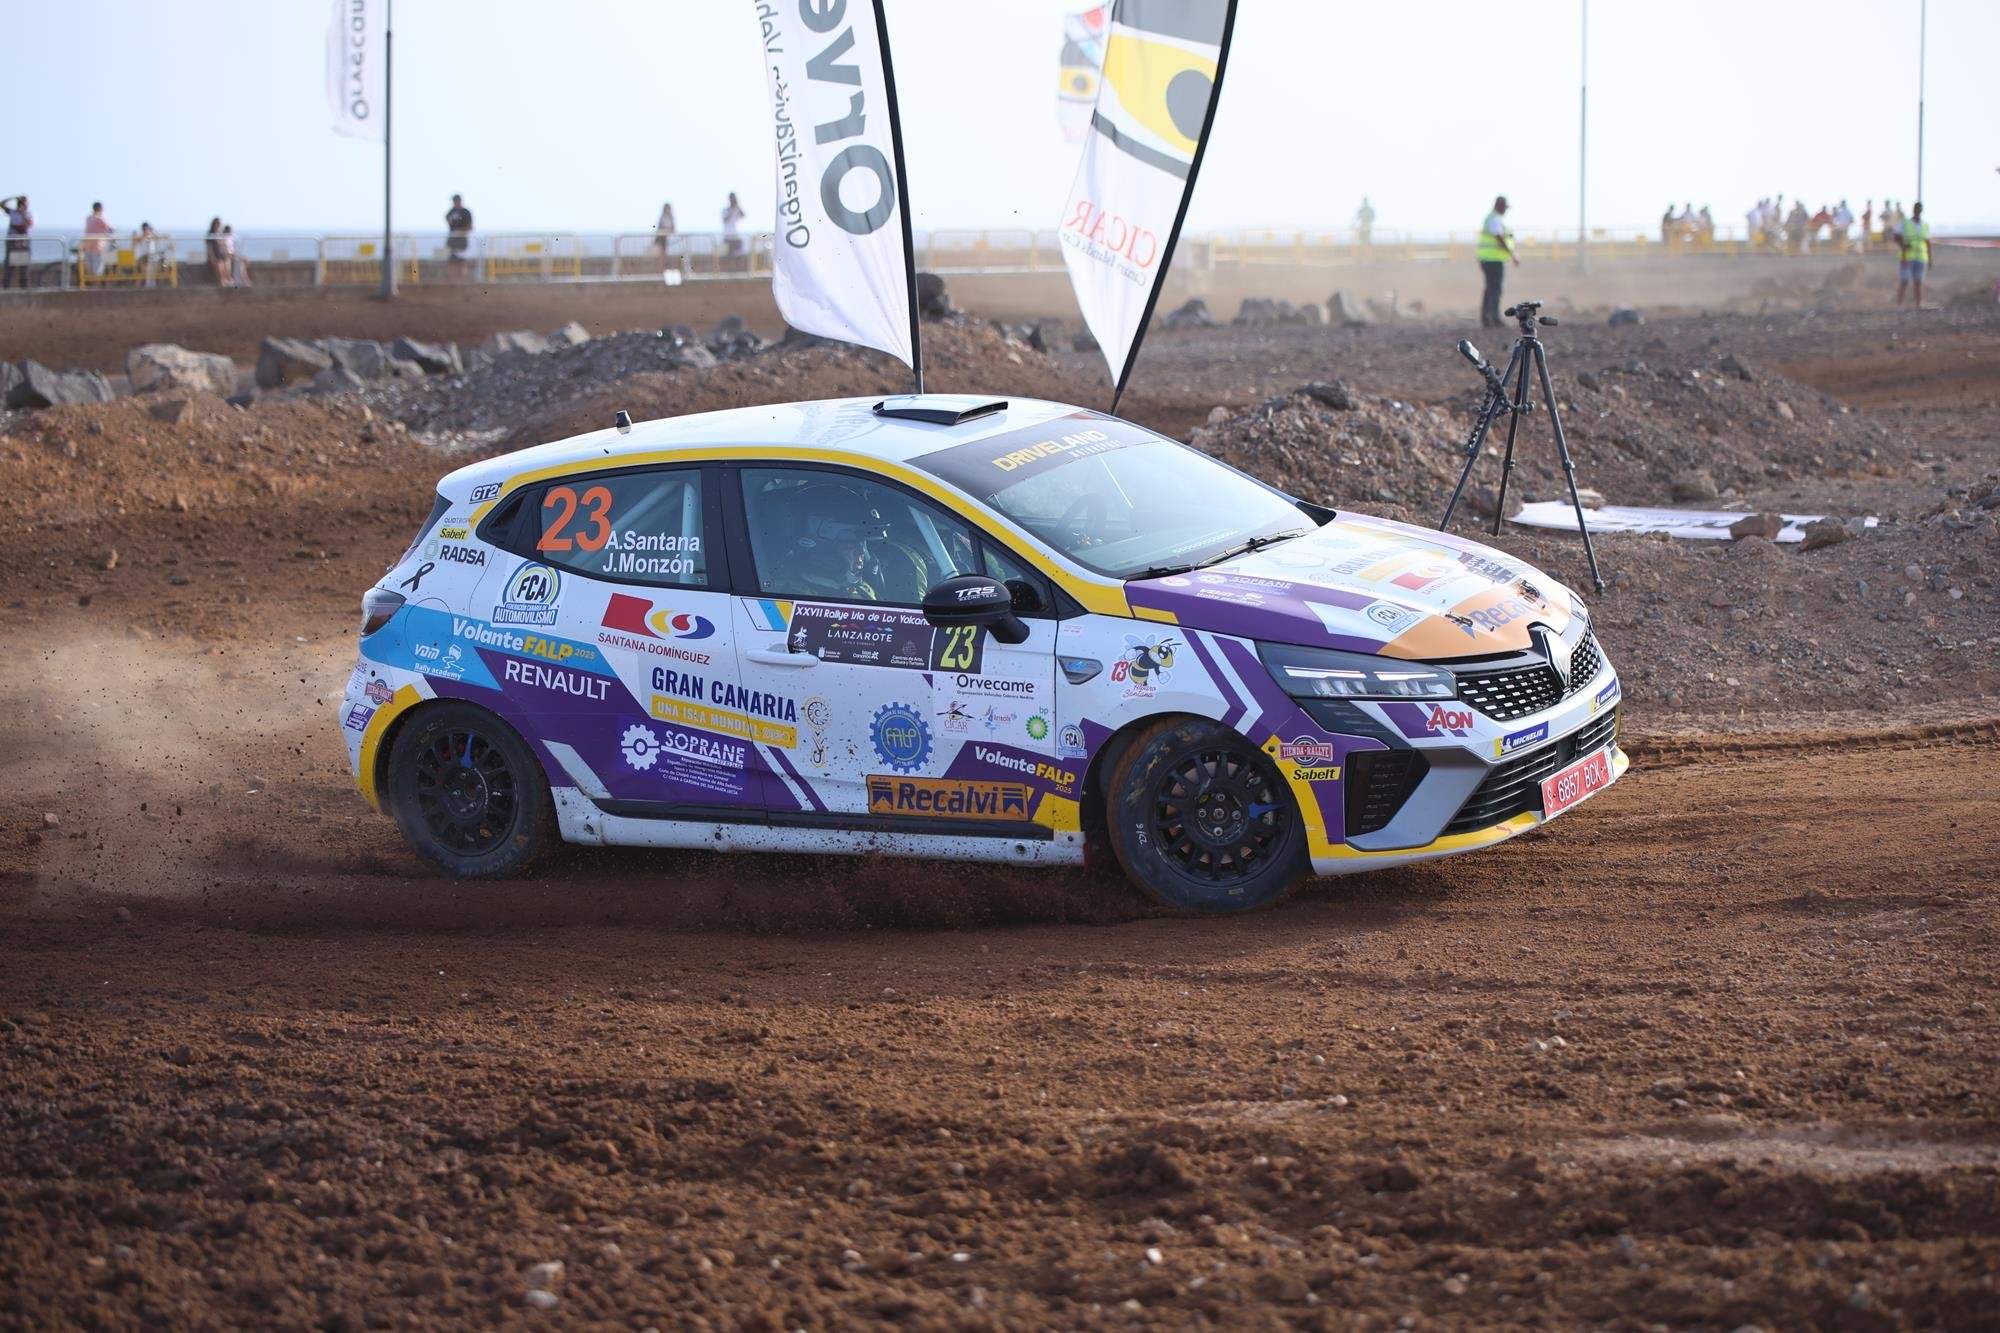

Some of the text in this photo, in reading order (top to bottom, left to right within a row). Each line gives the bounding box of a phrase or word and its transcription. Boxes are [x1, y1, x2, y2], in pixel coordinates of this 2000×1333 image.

[991, 430, 1109, 472] DRIVELAND
[472, 483, 498, 501] GT2
[535, 486, 614, 552] 23
[440, 527, 467, 540] Sabelt
[603, 530, 700, 552] A.Santana
[440, 544, 486, 566] RADSA
[602, 551, 695, 574] J.Monzón
[516, 574, 547, 601] FCA
[955, 586, 996, 600] TRS
[493, 608, 556, 624] AUTOMOVILISMO
[795, 606, 931, 626] XXVII Rallye Isla de Los Volcan
[827, 629, 893, 643] LANZAROTE
[574, 648, 597, 660] 2025
[598, 632, 710, 666] SANTANA DOMÍNGUEZ
[940, 625, 977, 670] 23
[414, 662, 462, 681] Rally academy
[505, 659, 611, 700] RENAULT
[1111, 660, 1129, 682] 13
[956, 674, 1035, 693] Orvecame
[652, 666, 797, 723] GRAN CANARIA
[657, 701, 679, 717] UNA
[682, 707, 707, 724] ISLA
[710, 712, 759, 737] MUNDIAL
[1039, 707, 1049, 715] bp
[944, 720, 968, 730] CICAR
[665, 730, 746, 764] SOPRANE
[1065, 732, 1078, 746] FCA
[1512, 728, 1545, 747] MICHELIN
[1293, 768, 1336, 780] Sabelt
[1055, 784, 1073, 794] 2025
[1557, 770, 1581, 803] 6857
[897, 782, 999, 814] Recalvi
